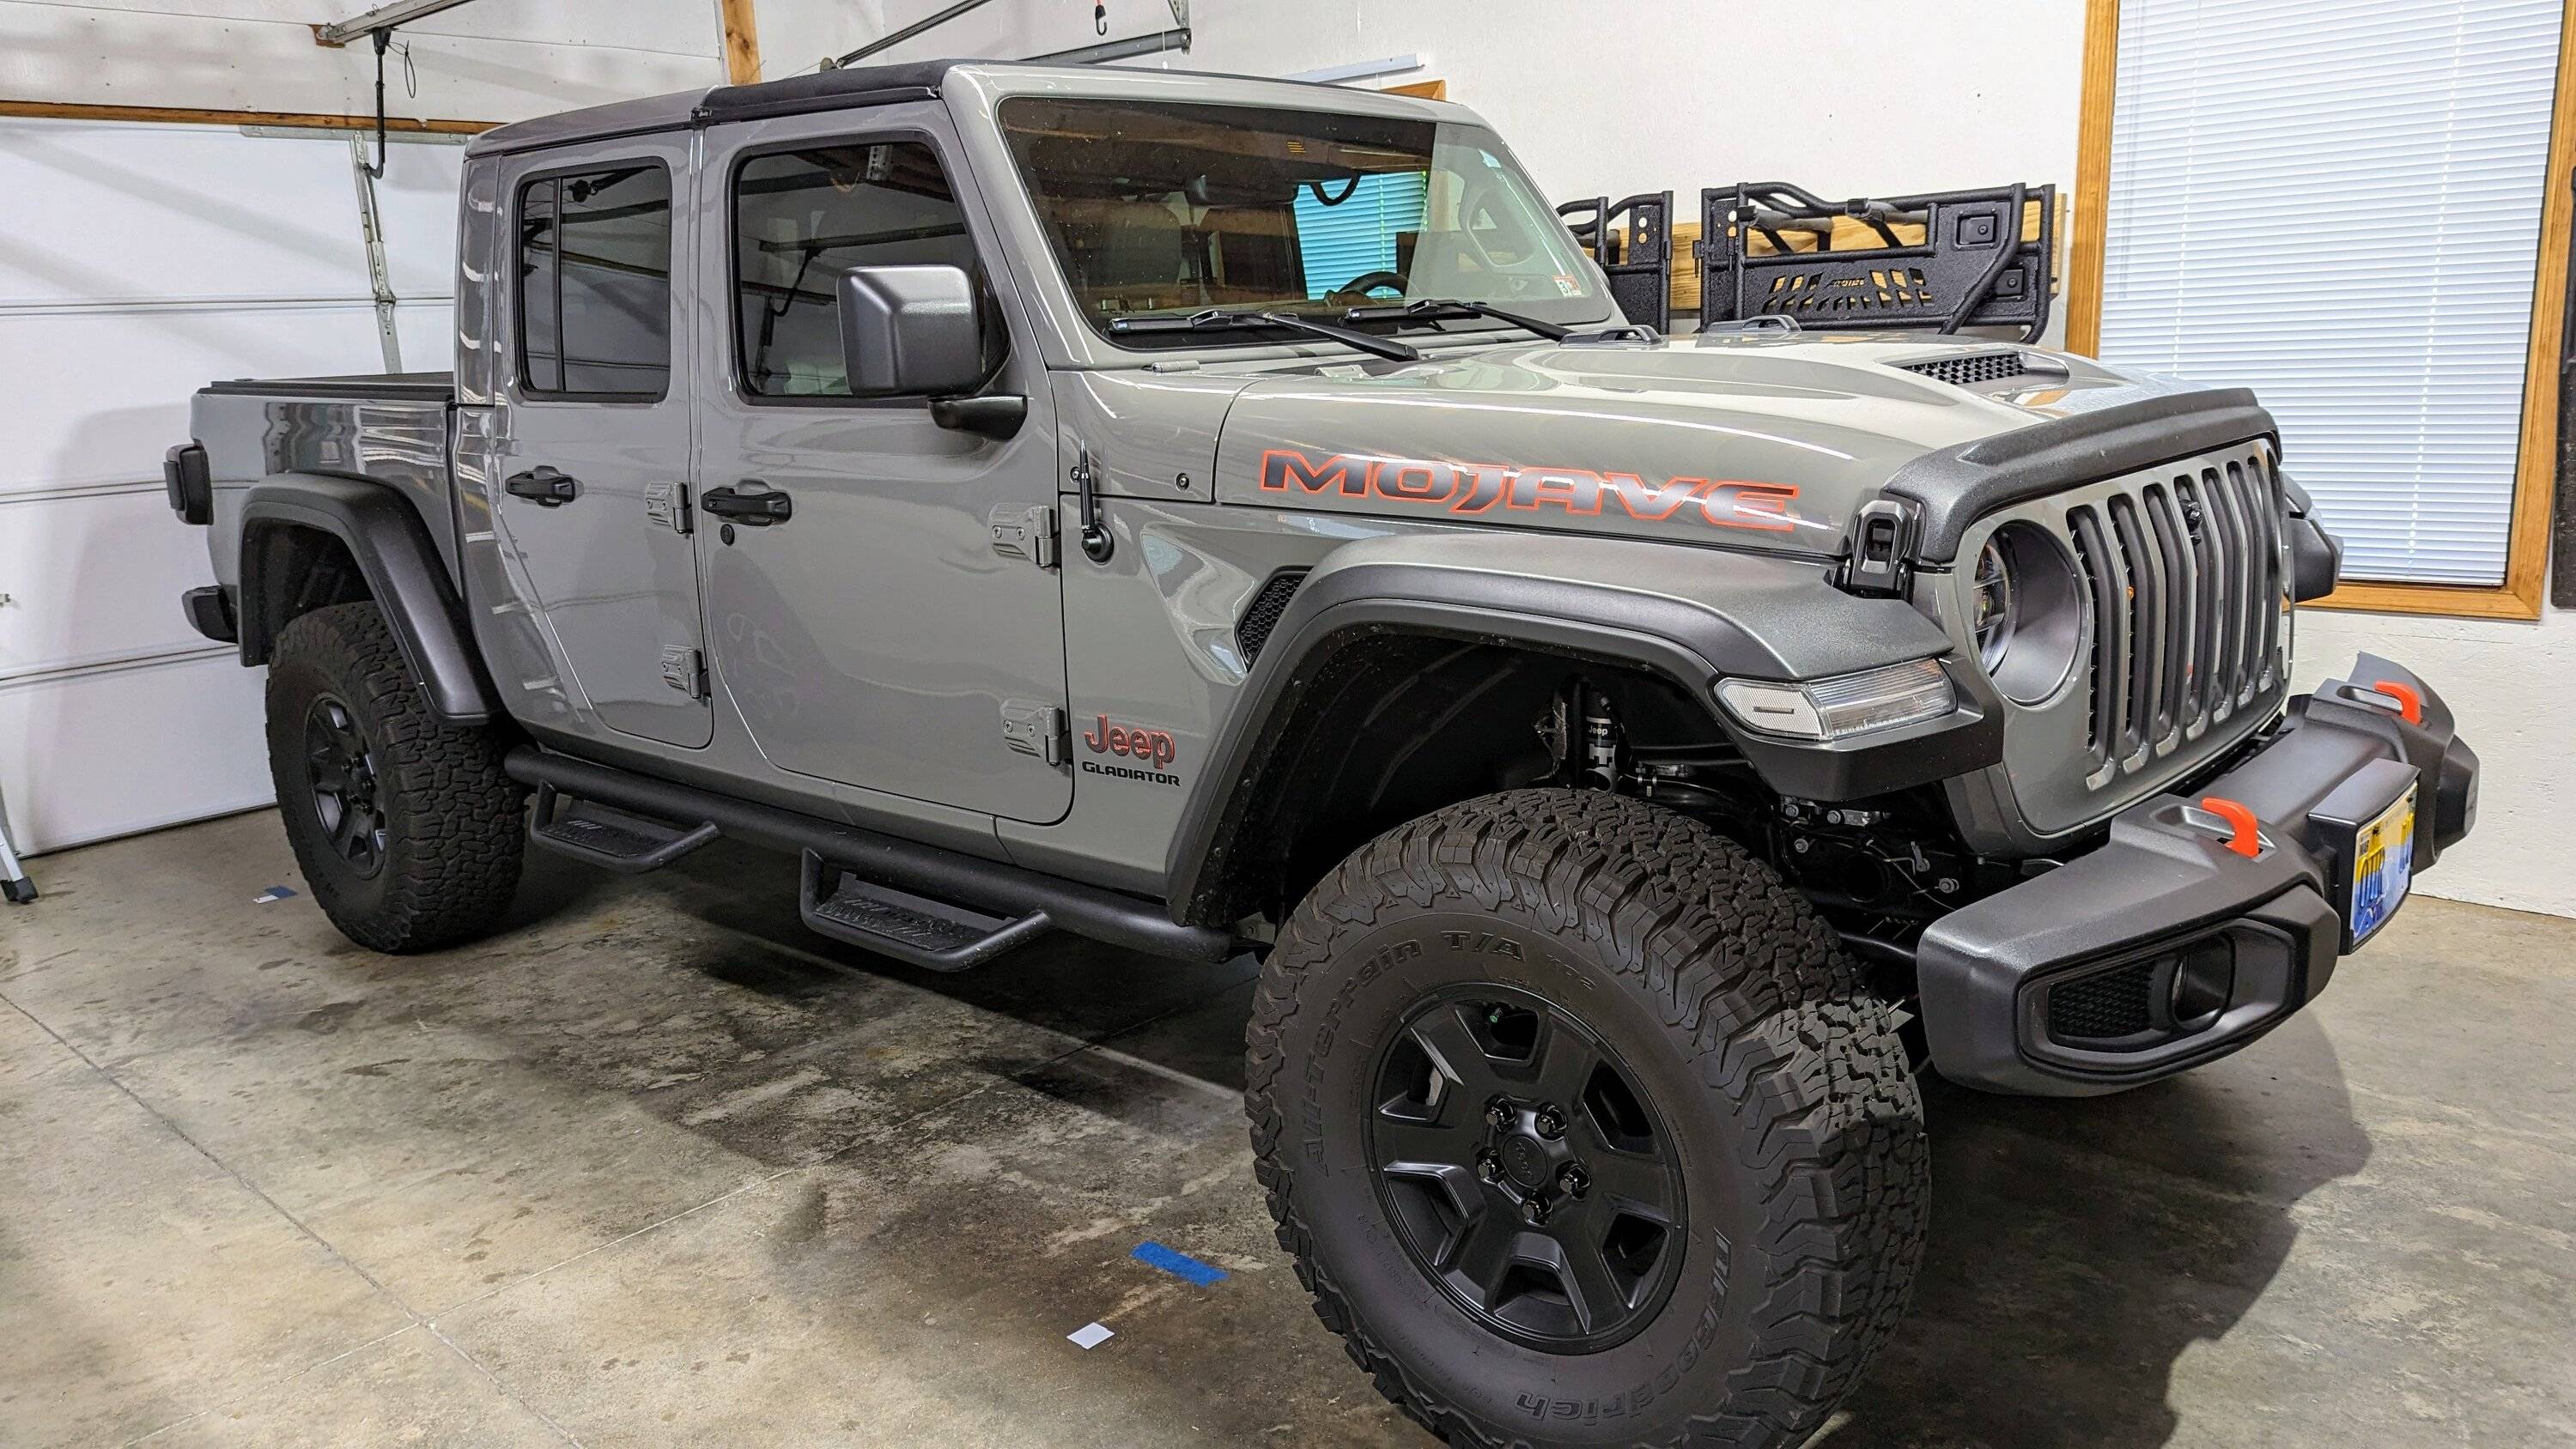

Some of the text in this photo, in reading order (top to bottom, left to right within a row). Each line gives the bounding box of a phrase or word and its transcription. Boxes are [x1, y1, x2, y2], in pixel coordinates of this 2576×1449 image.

[1260, 450, 1800, 531] MOJAVE
[1084, 714, 1176, 770] Jeep
[1589, 724, 1608, 737] Jeep
[1082, 761, 1182, 787] GLADIATOR
[1441, 930, 1527, 962] T/A
